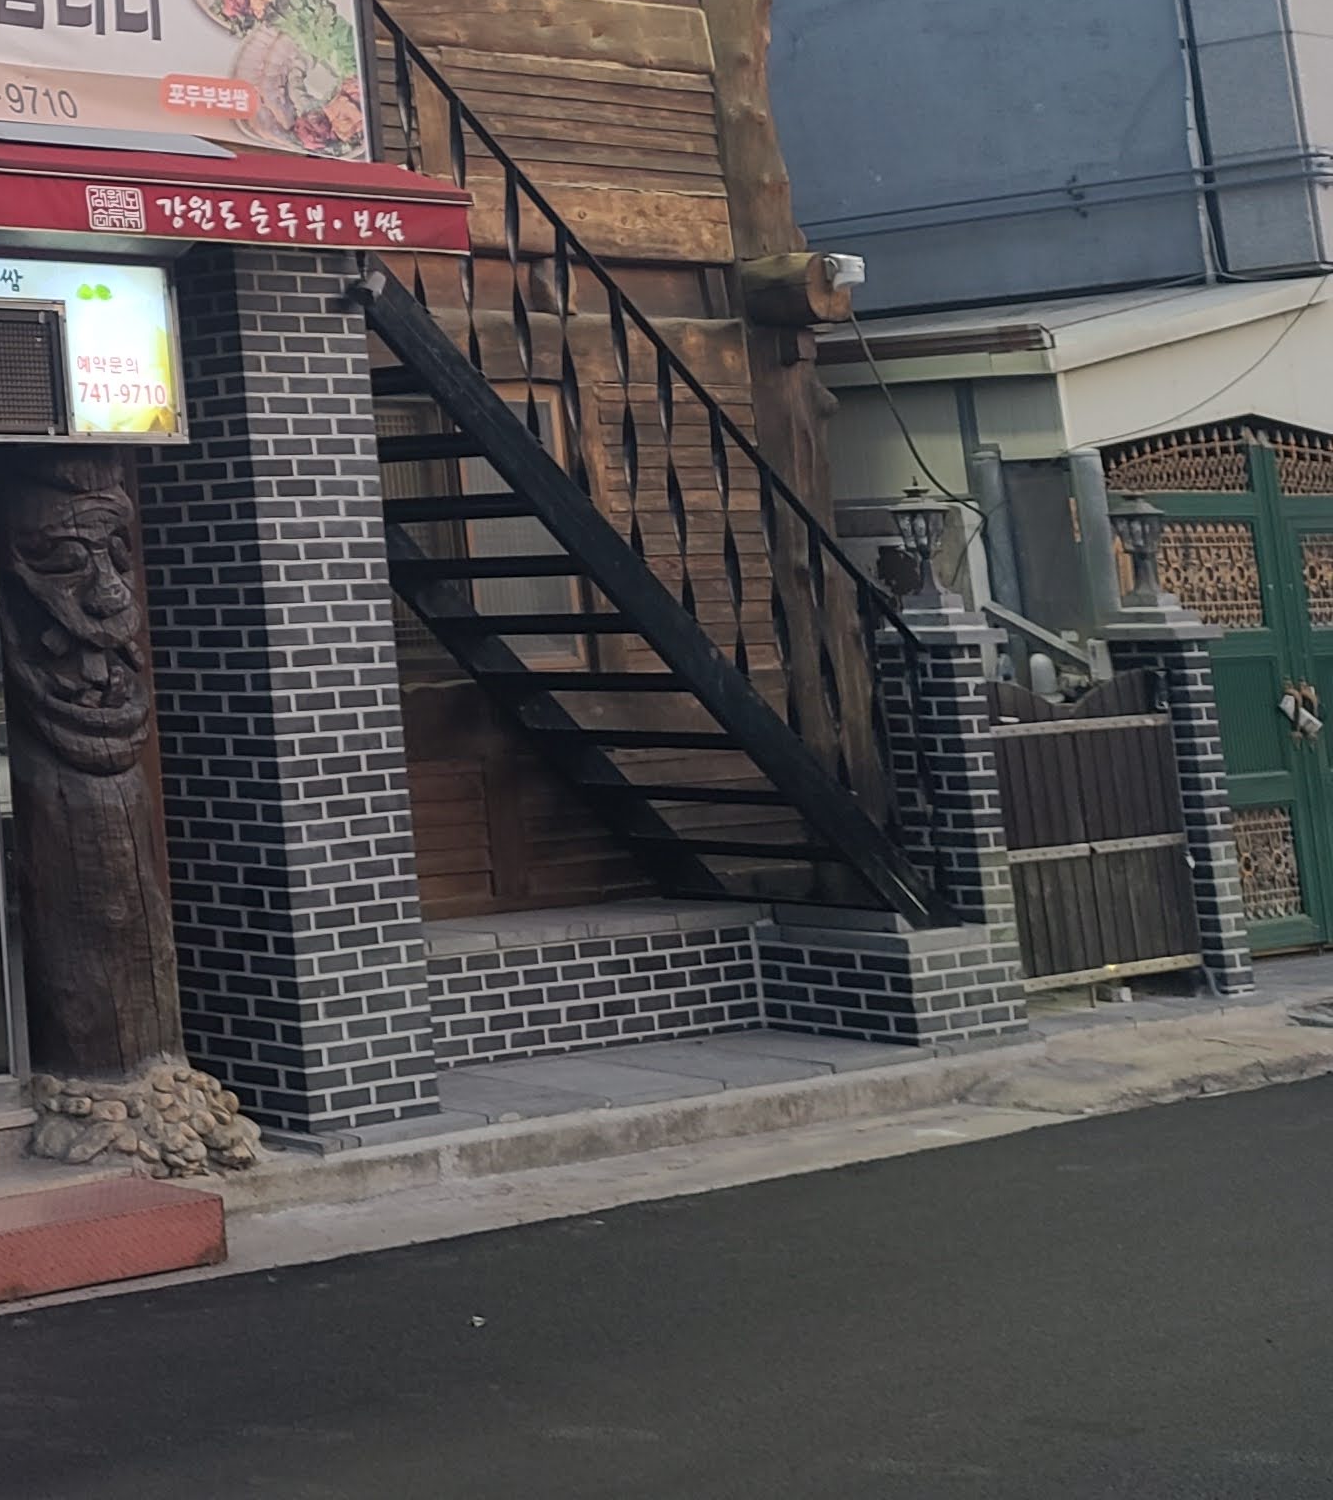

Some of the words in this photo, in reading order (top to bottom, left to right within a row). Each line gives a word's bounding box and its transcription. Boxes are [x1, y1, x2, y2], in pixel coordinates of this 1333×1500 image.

[167, 83, 252, 114] 포두부보쌈
[75, 353, 140, 375] 예약문의
[76, 381, 167, 406] 741-9710
